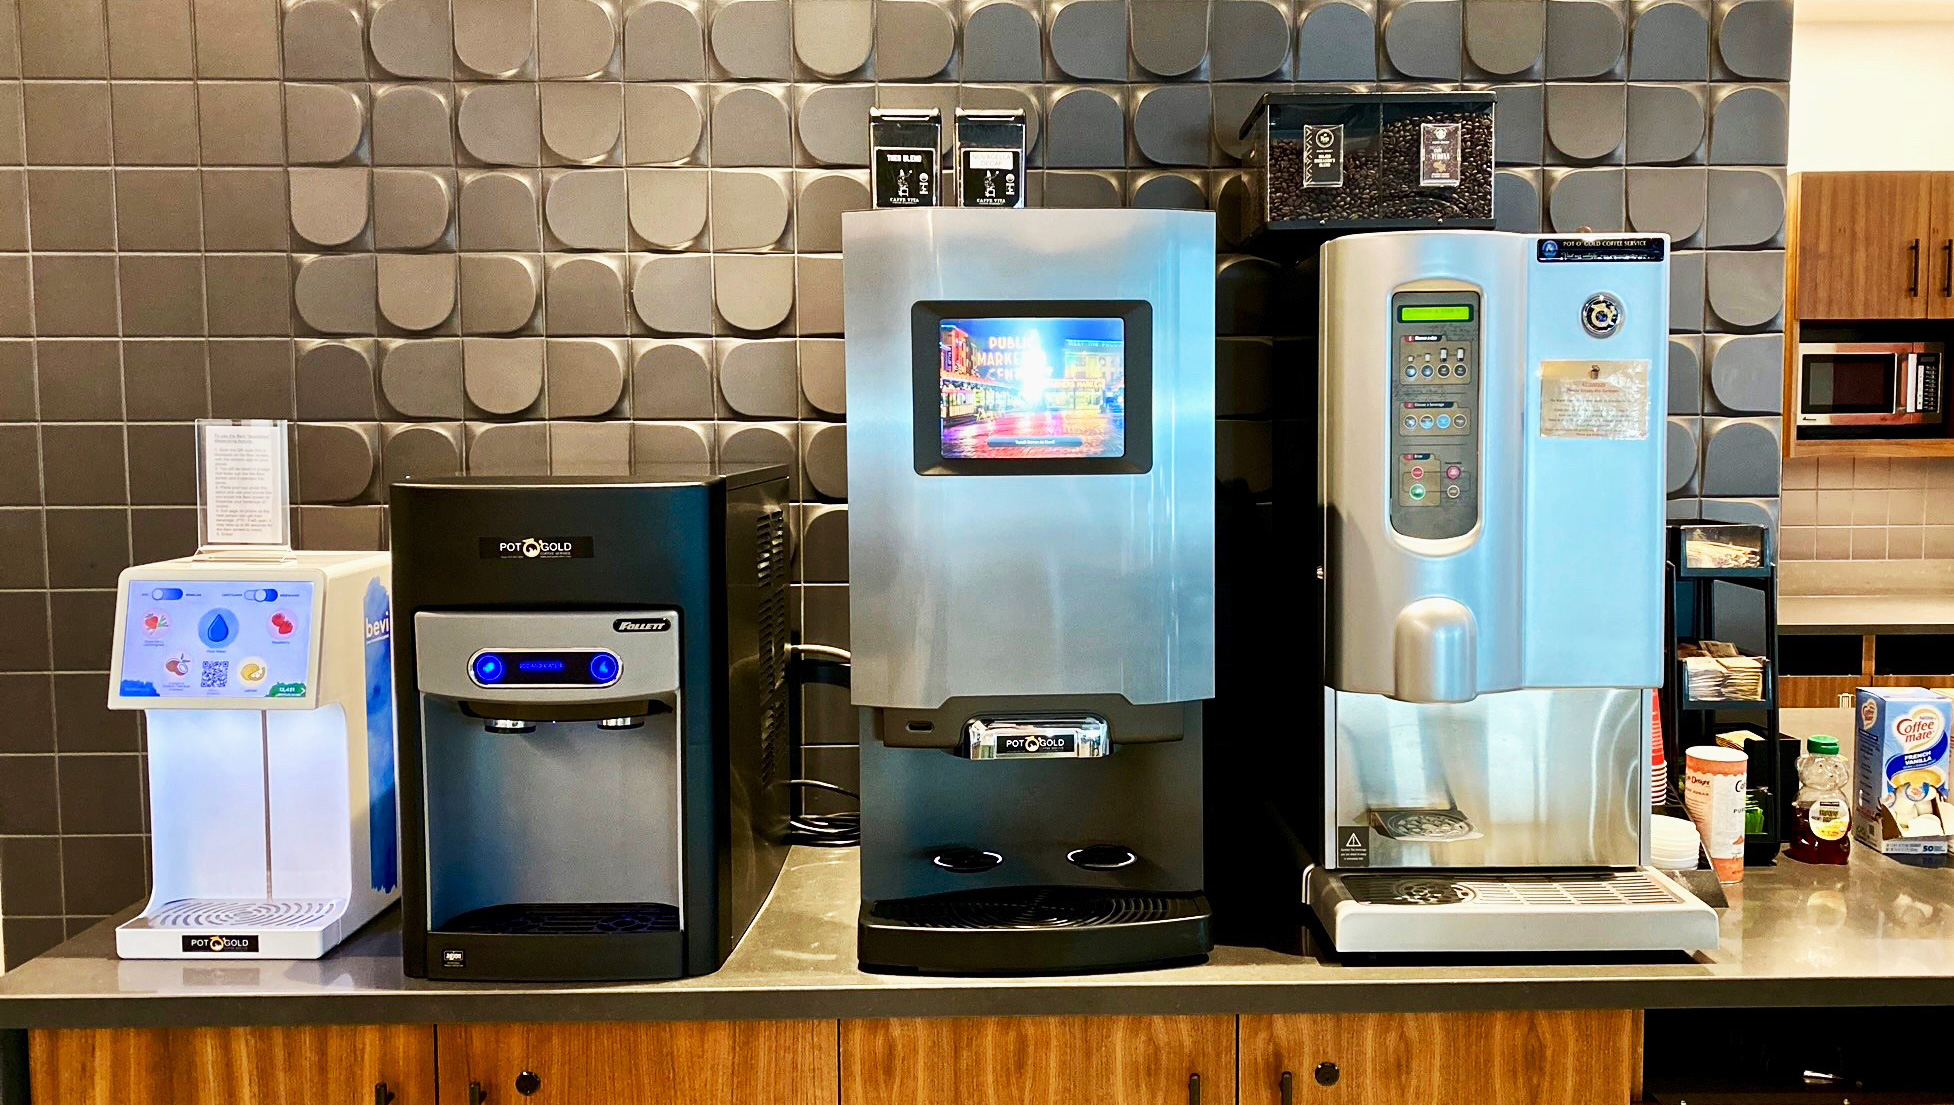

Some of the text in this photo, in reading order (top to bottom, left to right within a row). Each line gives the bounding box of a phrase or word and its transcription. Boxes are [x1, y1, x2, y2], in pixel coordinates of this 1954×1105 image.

[500, 543, 521, 551] POT
[541, 542, 572, 551] GOLD
[366, 611, 388, 638] bevi
[1896, 718, 1934, 735] Coffee
[1905, 730, 1932, 742] mate
[1905, 750, 1931, 760] FRENCH
[1905, 756, 1932, 765] VANILLA
